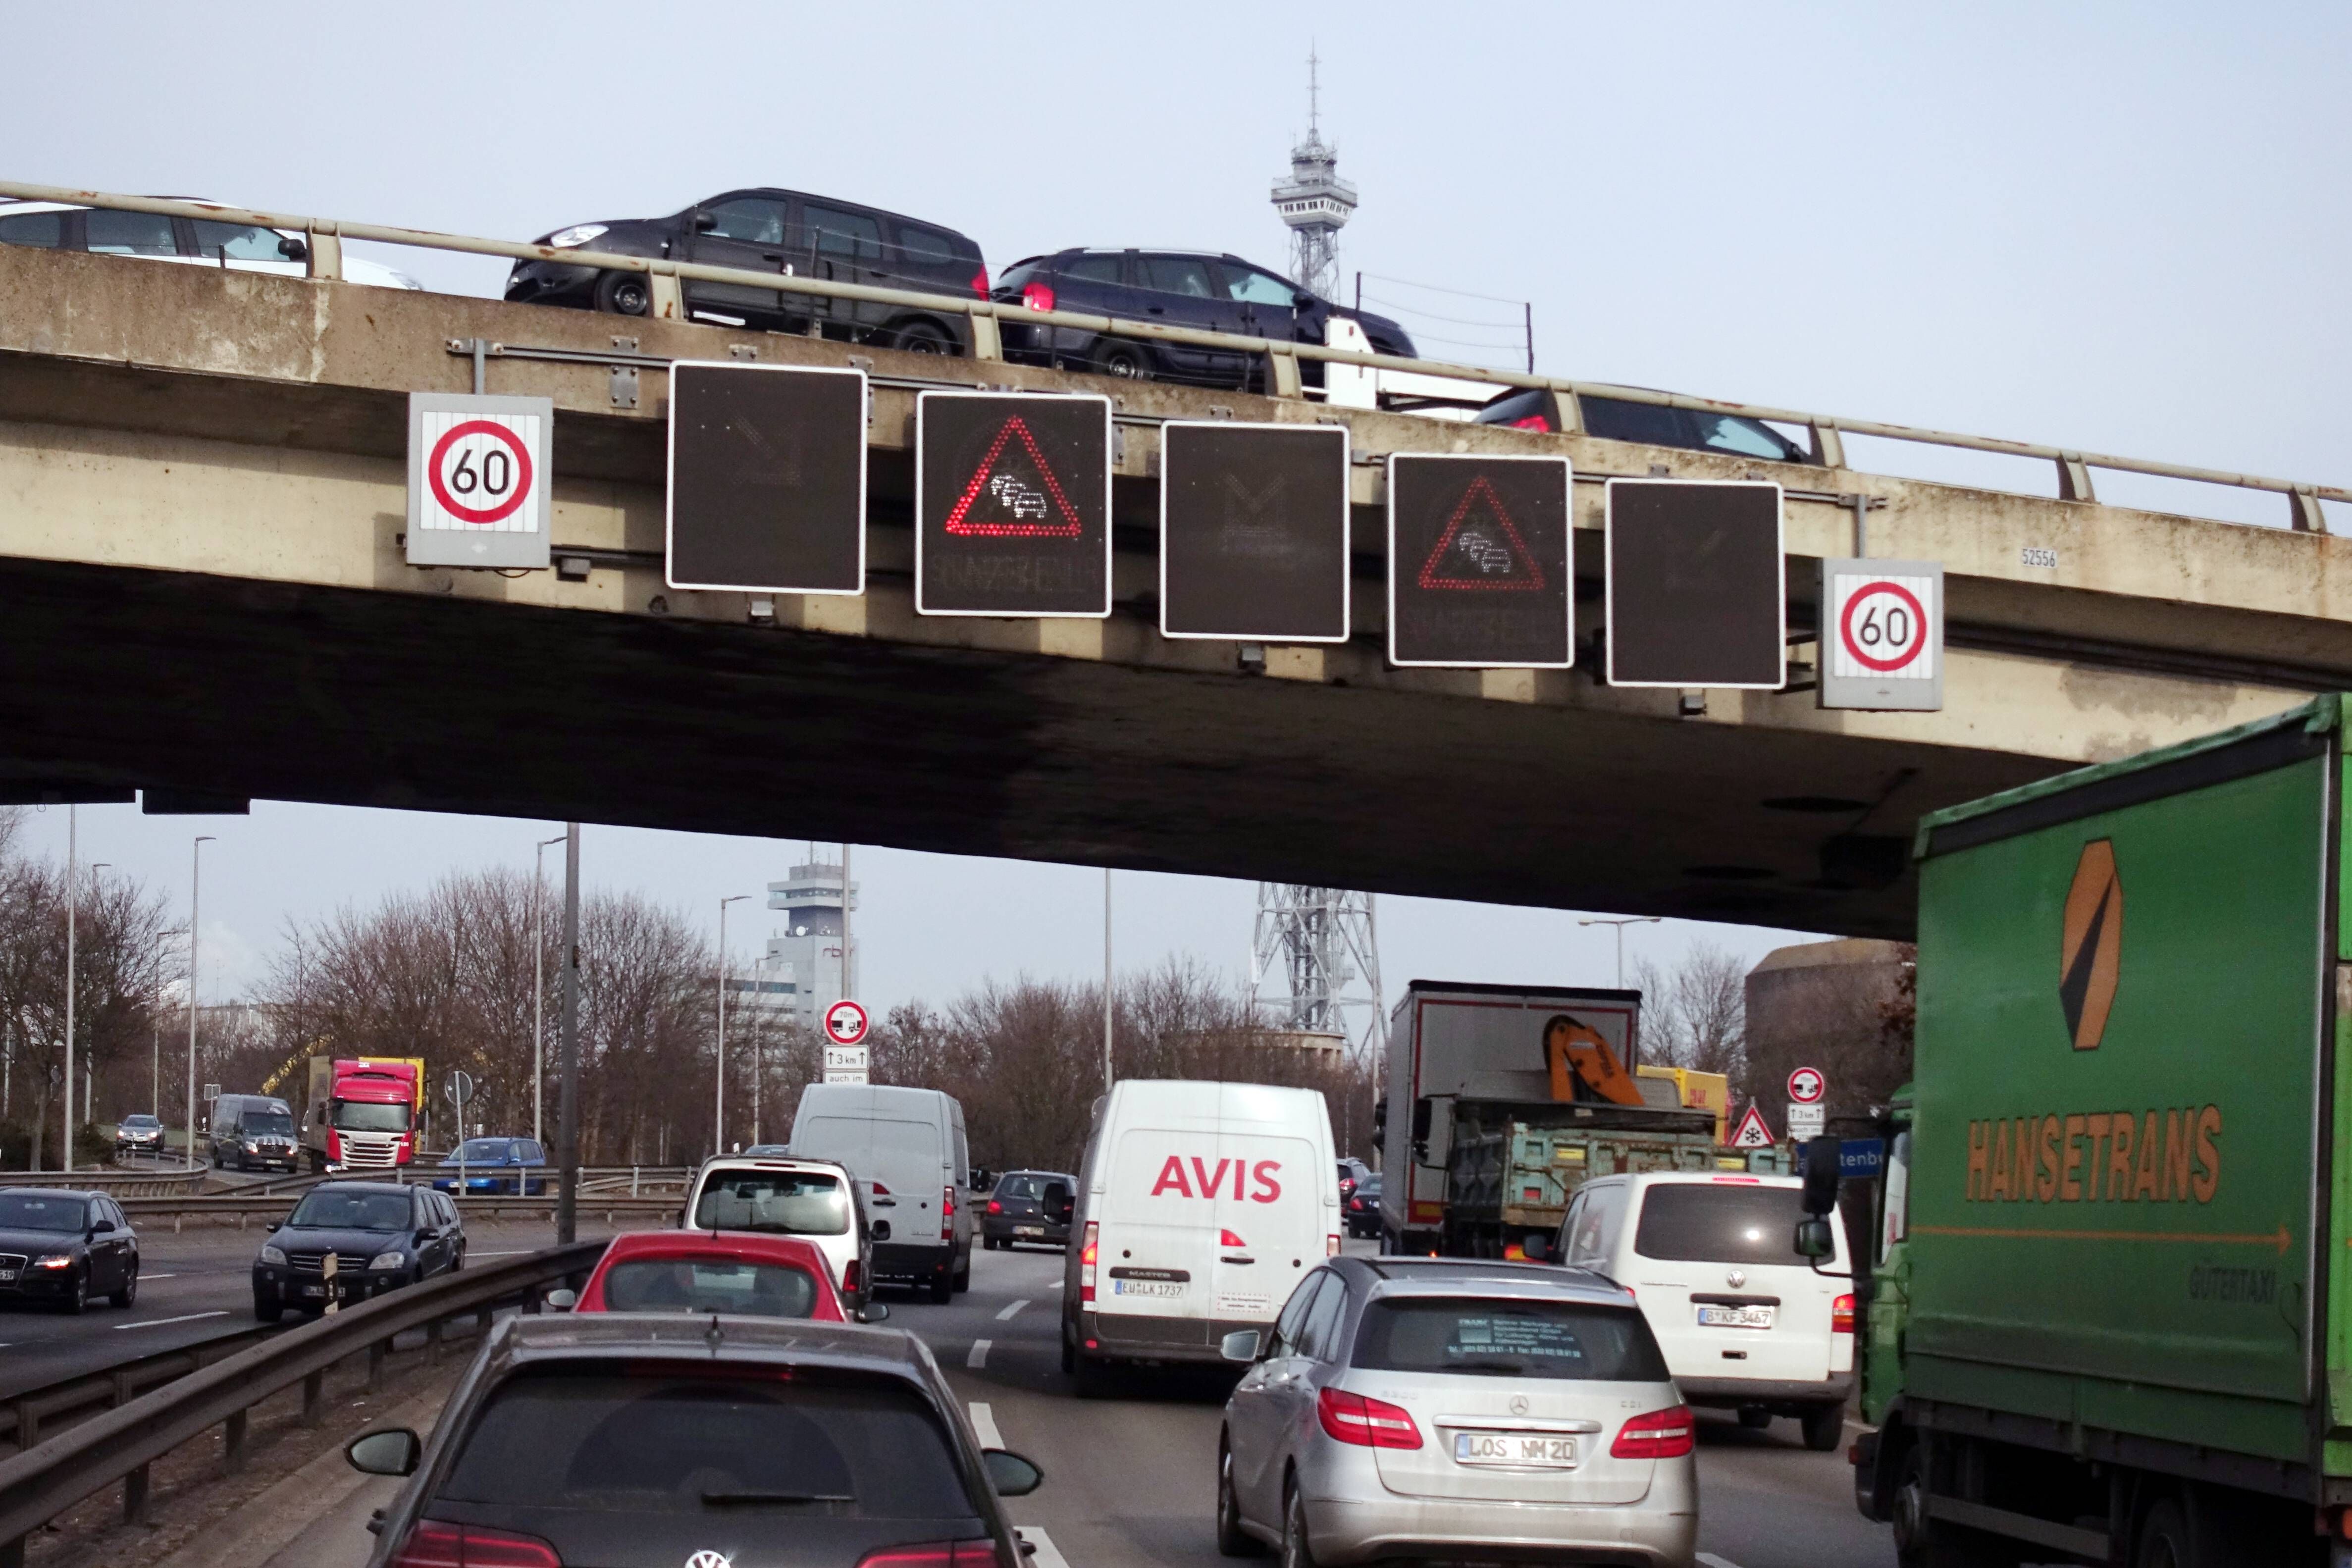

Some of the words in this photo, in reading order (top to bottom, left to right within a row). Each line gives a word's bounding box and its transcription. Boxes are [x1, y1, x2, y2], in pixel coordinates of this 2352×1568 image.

[451, 449, 510, 495] 60
[2022, 548, 2055, 568] 52556
[1859, 606, 1908, 647] 60
[836, 1054, 843, 1064] 3
[845, 1056, 856, 1064] km
[1965, 1103, 2222, 1203] HANSETRANS
[1150, 1155, 1282, 1203] AVIS
[1122, 1283, 1136, 1294] EU
[1468, 1437, 1508, 1458] LOS
